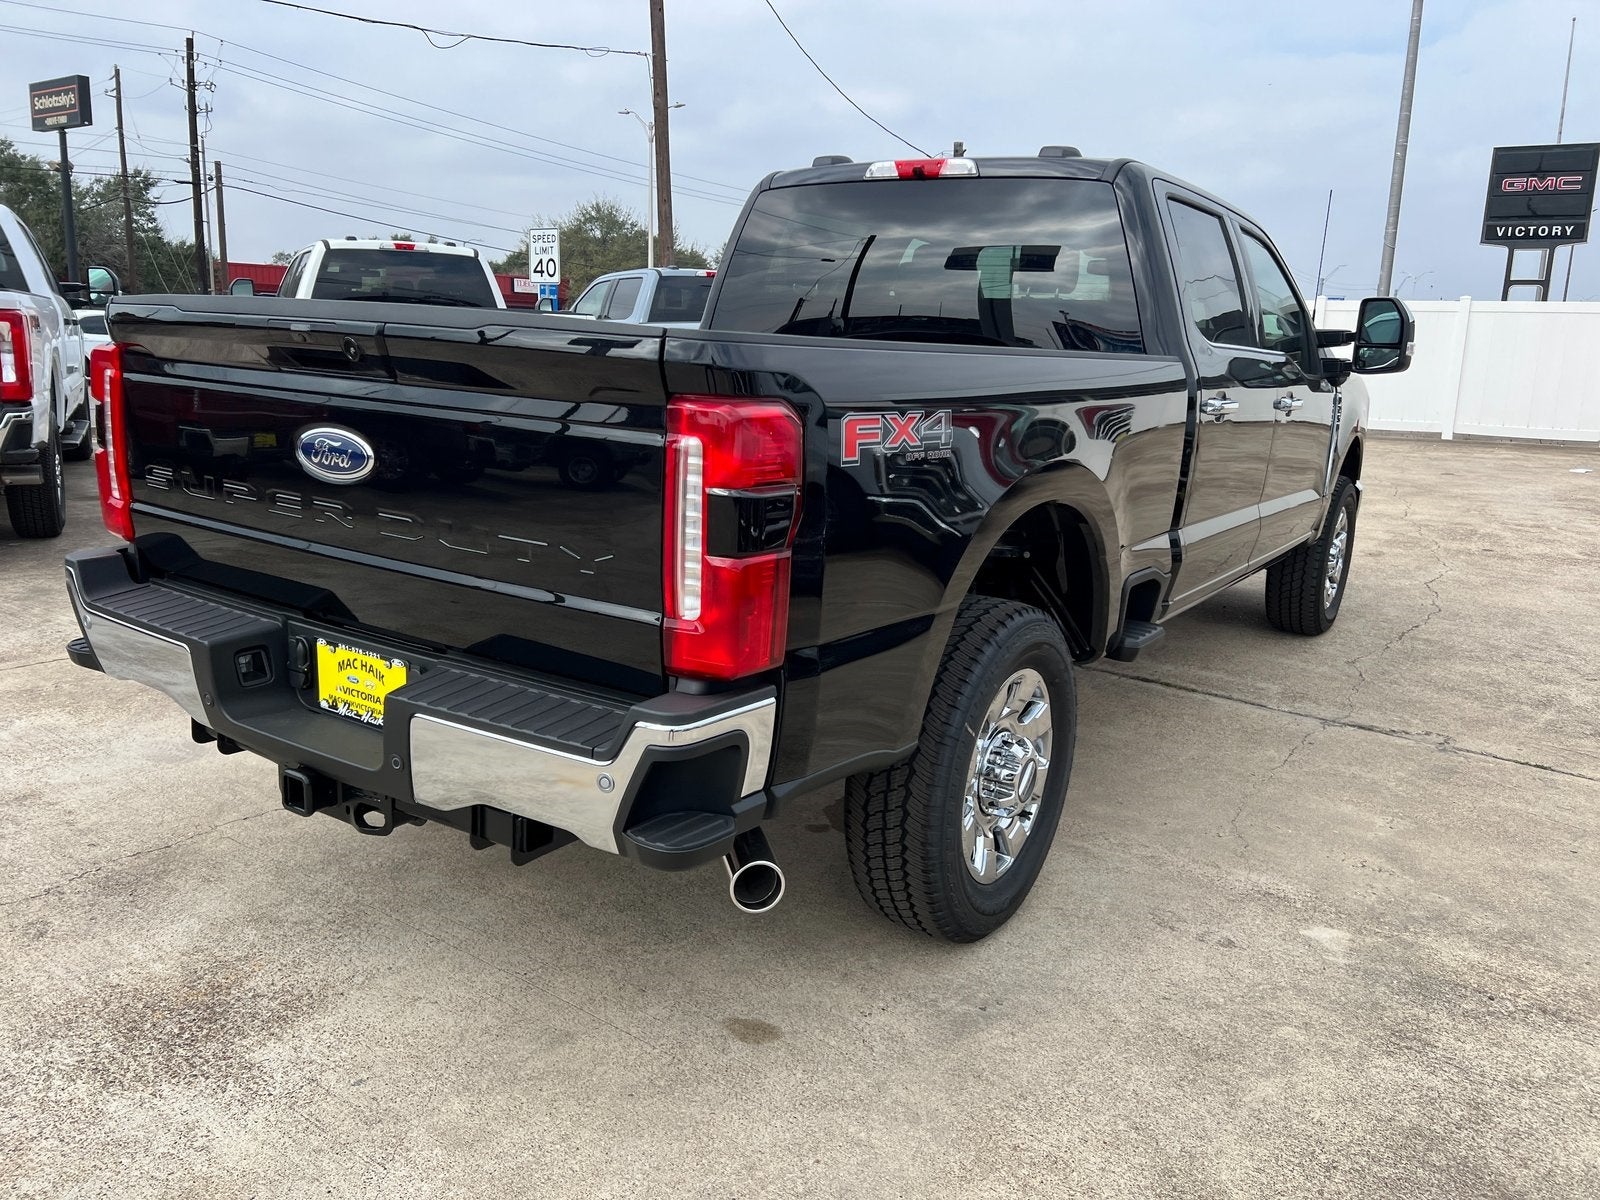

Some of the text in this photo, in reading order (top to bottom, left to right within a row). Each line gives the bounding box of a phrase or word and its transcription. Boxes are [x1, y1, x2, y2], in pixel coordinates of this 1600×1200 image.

[34, 91, 75, 110] Schlotzsky's
[1502, 176, 1583, 192] GMC
[532, 234, 557, 244] SPEED
[1496, 225, 1575, 237] VICTORY
[534, 246, 554, 255] LIMIT
[533, 257, 557, 278] 40
[841, 409, 953, 467] FX4
[311, 437, 352, 468] Ford
[905, 449, 952, 461] OFF ROAD
[144, 464, 615, 575] SUPER DUTY
[337, 658, 358, 673] MAC
[360, 660, 385, 686] HAIK
[342, 685, 383, 705] VICTORIA
[338, 703, 384, 726] Mac Haik
